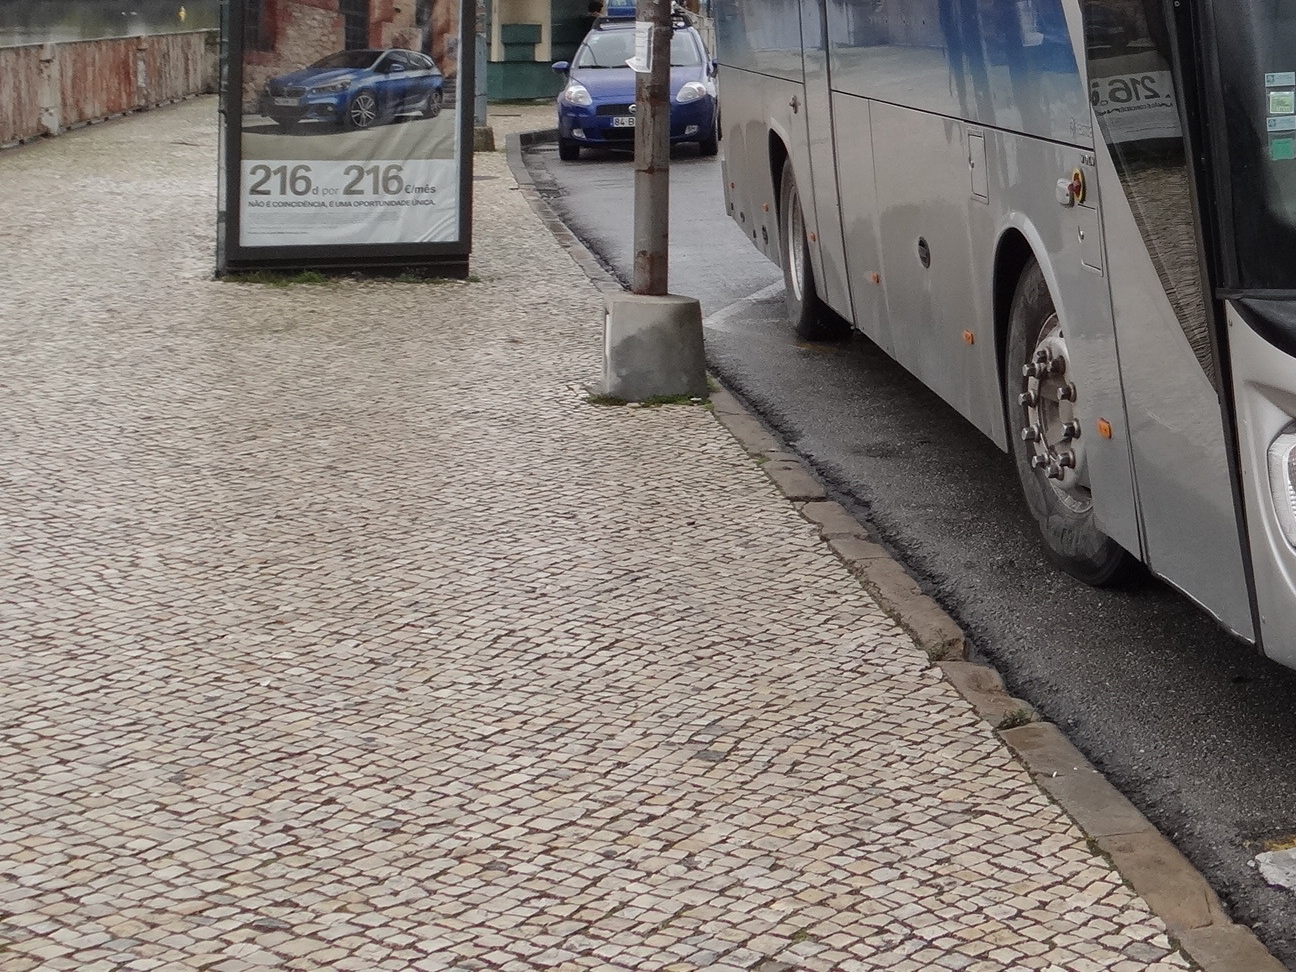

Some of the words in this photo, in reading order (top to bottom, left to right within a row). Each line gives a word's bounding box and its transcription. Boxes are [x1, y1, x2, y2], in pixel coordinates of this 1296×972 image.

[321, 187, 339, 196] por
[248, 199, 265, 208] NÃO
[353, 200, 411, 208] OPORTUNIDADE
